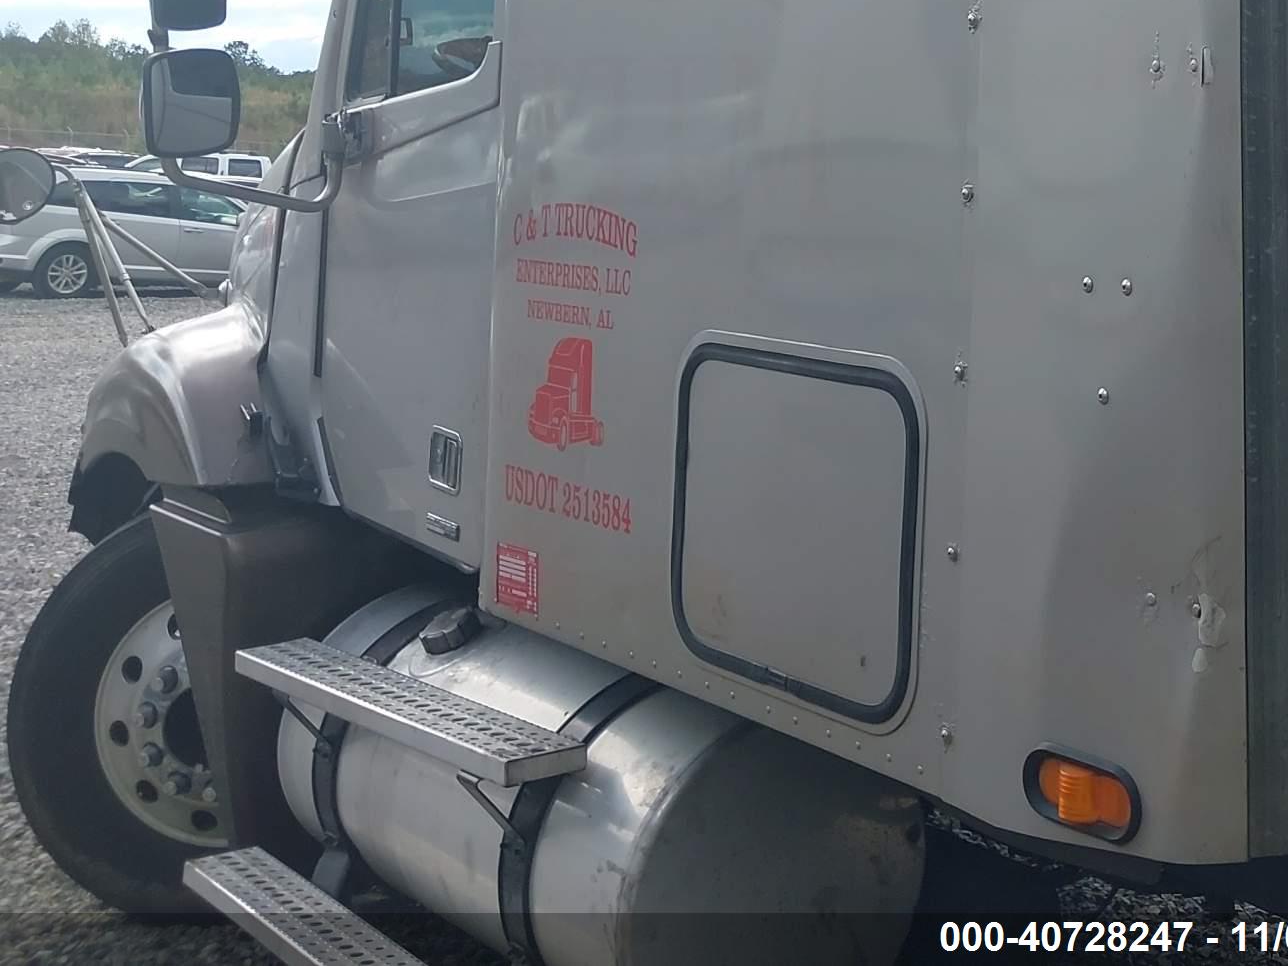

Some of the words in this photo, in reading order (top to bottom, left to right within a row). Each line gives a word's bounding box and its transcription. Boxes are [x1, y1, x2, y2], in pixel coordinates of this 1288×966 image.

[513, 213, 523, 247] C
[526, 209, 537, 242] &
[541, 204, 552, 238] T
[554, 202, 638, 257] TRUCKING
[516, 258, 602, 296] ENTERPRISES,
[605, 267, 632, 296] LLC
[527, 299, 592, 330] NEWBERN,
[596, 309, 615, 330] AL
[504, 464, 559, 514] USDOT
[562, 482, 632, 534] 2513584
